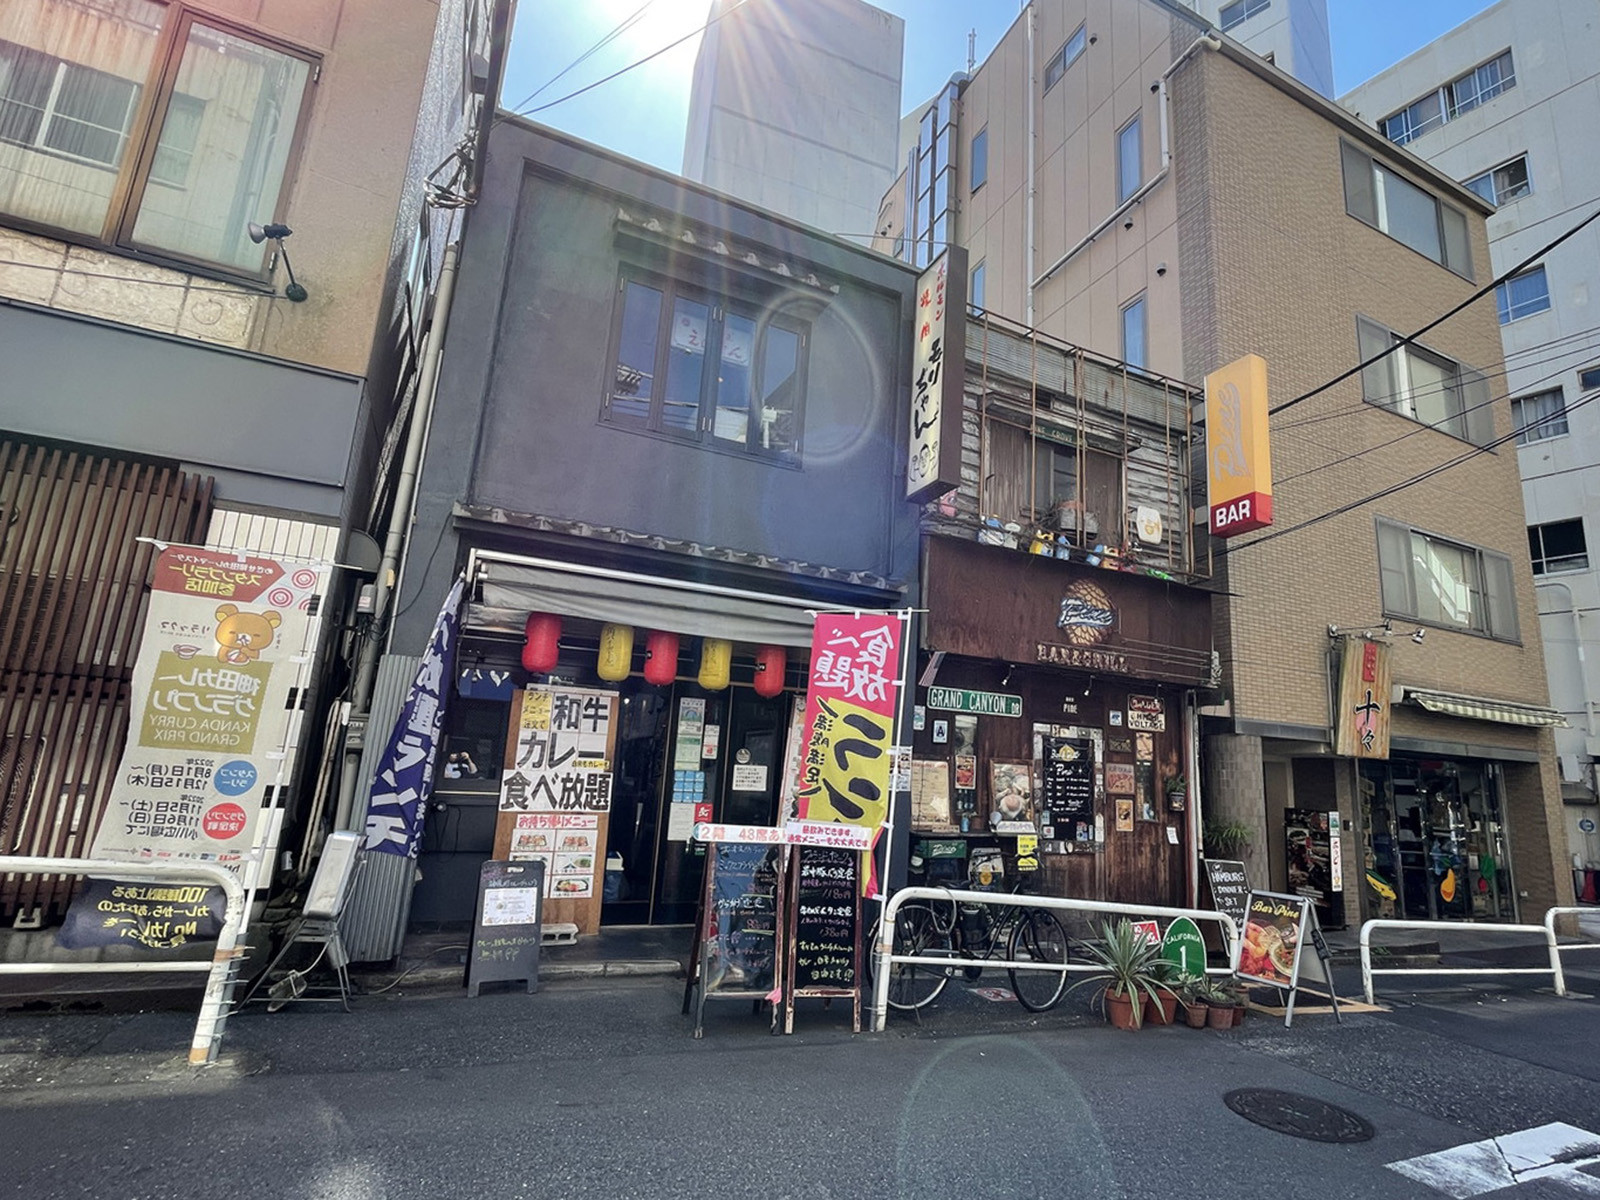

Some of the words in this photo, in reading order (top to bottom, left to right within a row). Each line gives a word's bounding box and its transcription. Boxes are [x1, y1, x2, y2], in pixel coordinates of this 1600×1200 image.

[1215, 499, 1251, 528] BAR
[552, 694, 609, 733] 和牛
[931, 689, 963, 708] GRAND
[969, 693, 1006, 713] CANYON
[1011, 703, 1020, 714] DR
[1353, 688, 1381, 753] 十々
[517, 732, 605, 769] カレー
[501, 771, 611, 811] 食べ放題
[1211, 872, 1245, 883] HAMBURG
[1217, 886, 1243, 894] DINNER
[1251, 900, 1273, 913] Bar
[1274, 904, 1299, 918] Pine
[1166, 933, 1201, 945] CALIFORNIA
[1179, 945, 1187, 972] 1
